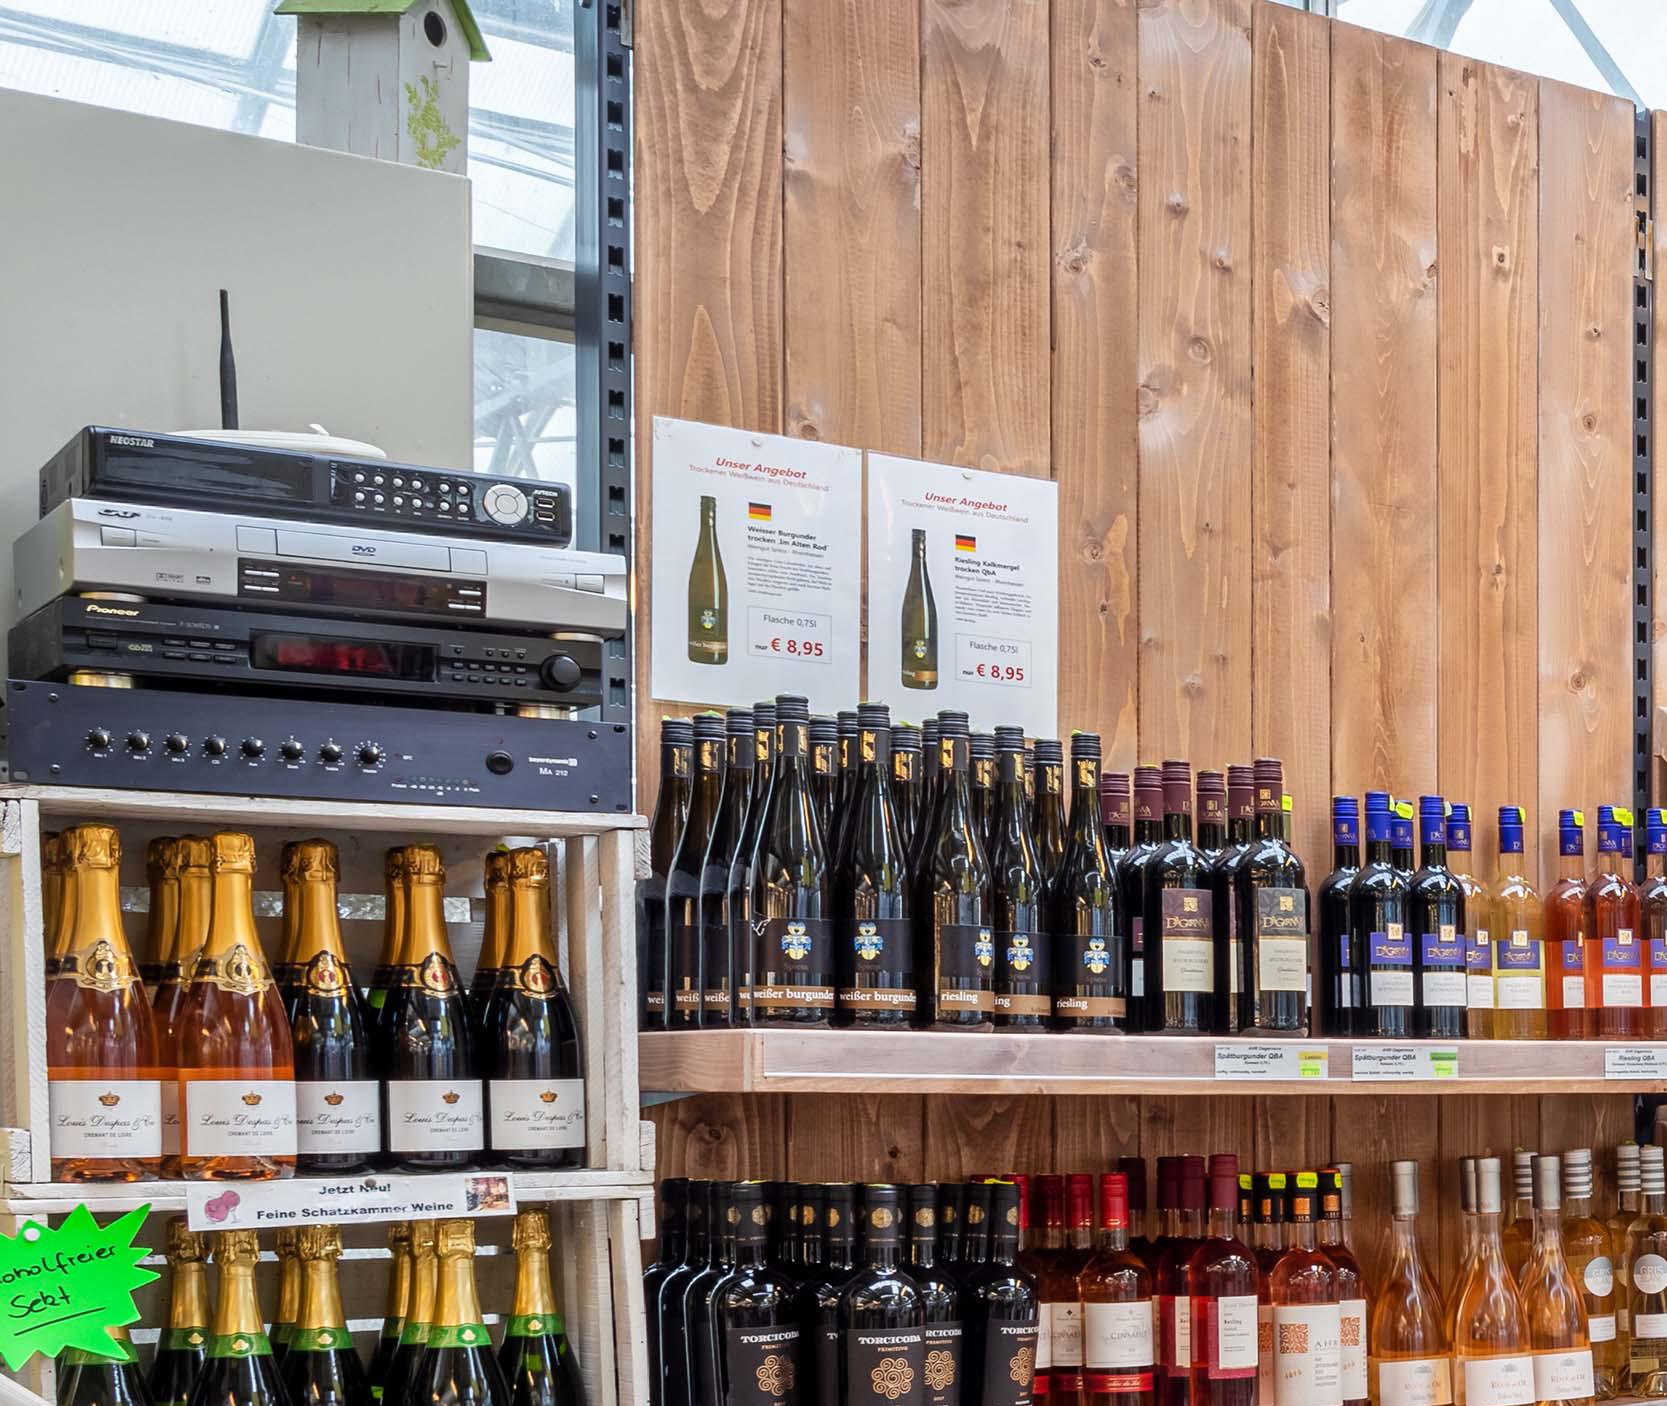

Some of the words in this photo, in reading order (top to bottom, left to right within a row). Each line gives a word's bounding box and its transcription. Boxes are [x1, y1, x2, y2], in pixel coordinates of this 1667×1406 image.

[110, 435, 154, 448] NEOSTAR
[716, 457, 751, 471] Unser
[754, 463, 807, 480] Angebot
[925, 492, 956, 505] Unser
[960, 497, 1008, 512] Angebot
[779, 530, 816, 541] Burgunder
[352, 545, 376, 555] DVD
[87, 604, 140, 617] Pioneer
[763, 614, 794, 626] Flasche
[771, 638, 781, 652] €
[787, 639, 823, 657] 8,95
[970, 641, 997, 652] Flasche
[977, 663, 985, 677] €
[991, 664, 1024, 681] 8,95
[754, 986, 784, 1001] weißer
[786, 986, 834, 1001] burgunder
[942, 990, 978, 1006] riesling
[319, 1183, 355, 1196] Jetzt
[257, 1207, 297, 1220] Feine
[301, 1204, 407, 1219] Schatzkammer
[411, 1200, 454, 1213] Weine
[0, 1245, 117, 1287] oholfreier
[858, 1335, 921, 1346] TORCICODA
